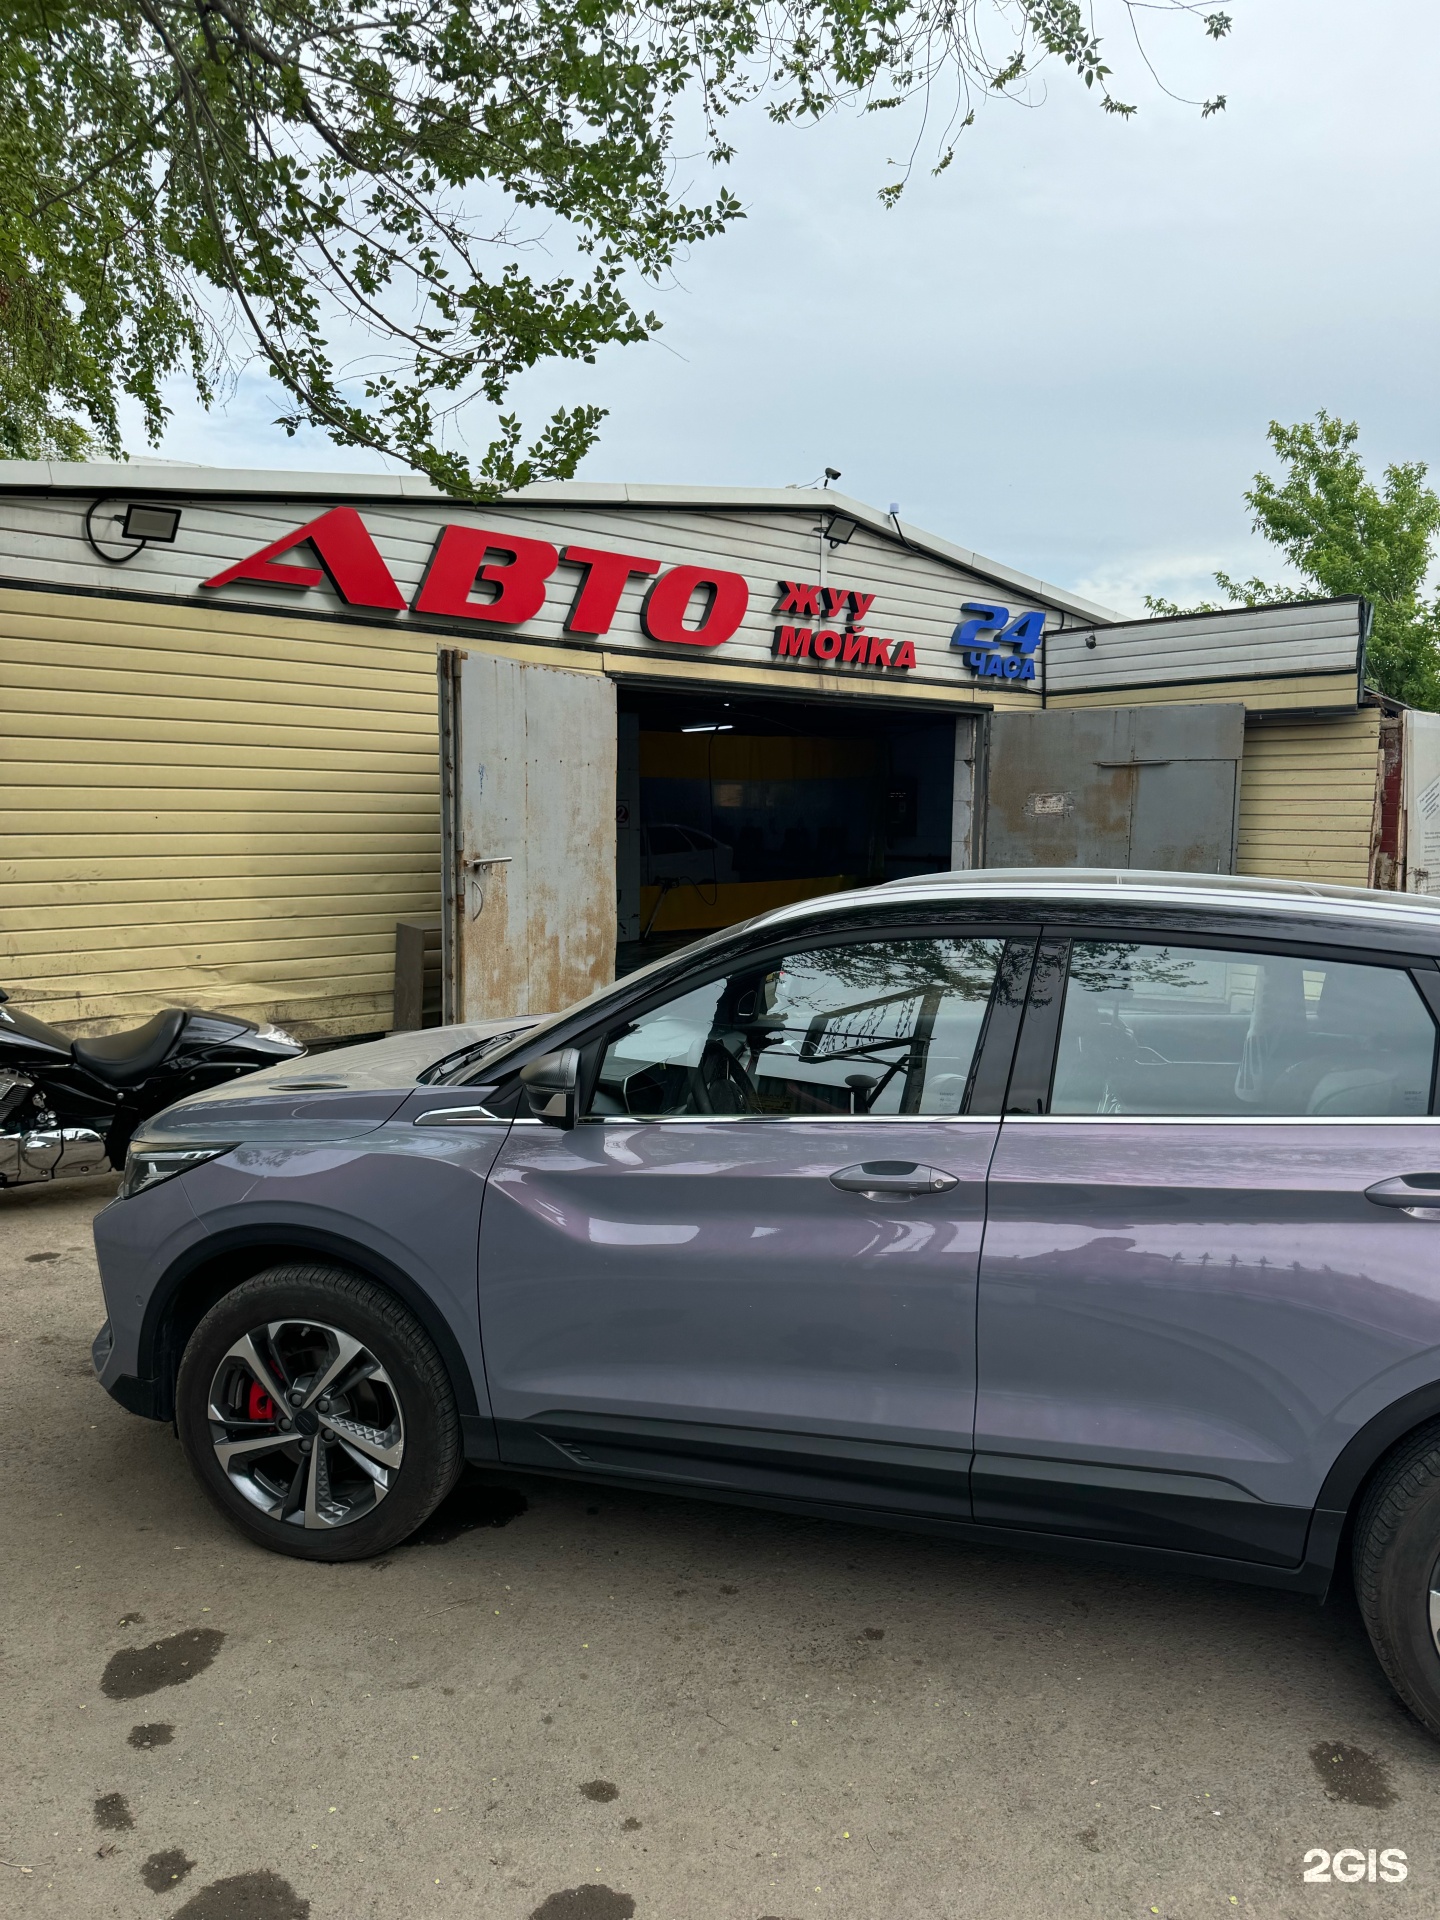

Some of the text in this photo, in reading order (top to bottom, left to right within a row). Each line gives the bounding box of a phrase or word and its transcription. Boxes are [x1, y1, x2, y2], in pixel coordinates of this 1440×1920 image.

[200, 506, 750, 648] АВТО
[774, 580, 877, 621] ЖУУ
[773, 624, 917, 669] МОЙКА
[952, 602, 1046, 654] 24
[964, 651, 1036, 681] ЧАСА
